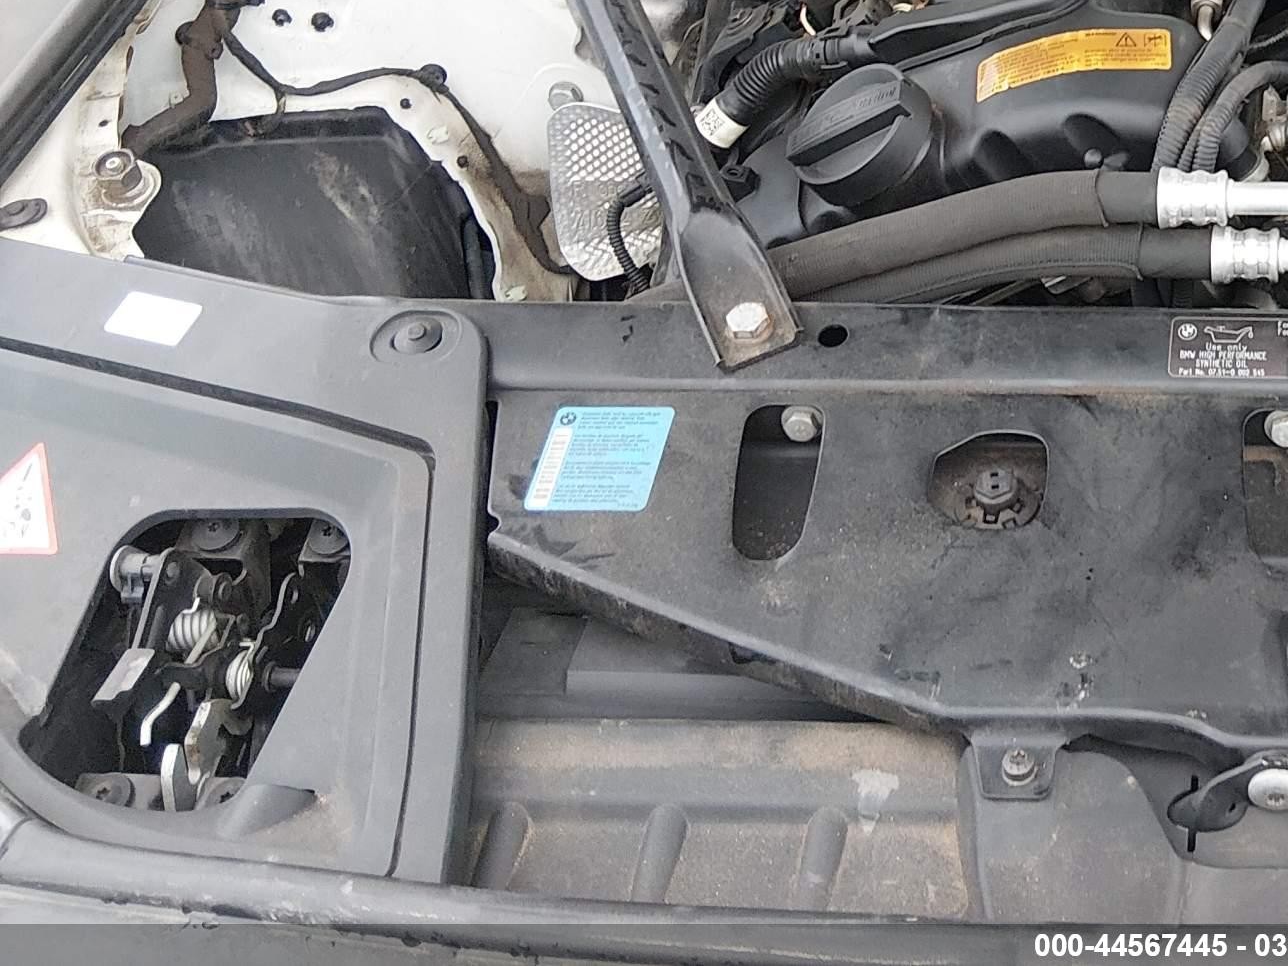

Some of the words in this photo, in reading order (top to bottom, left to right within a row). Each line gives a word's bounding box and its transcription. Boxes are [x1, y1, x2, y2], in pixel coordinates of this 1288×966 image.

[1206, 342, 1222, 351] Use
[1228, 342, 1247, 353] only
[1180, 350, 1196, 359] BMW
[1199, 350, 1216, 359] HIGH
[1219, 351, 1267, 361] PERFORMANCE
[1196, 359, 1233, 368] SYNTHETIC
[1236, 360, 1248, 368] OIL
